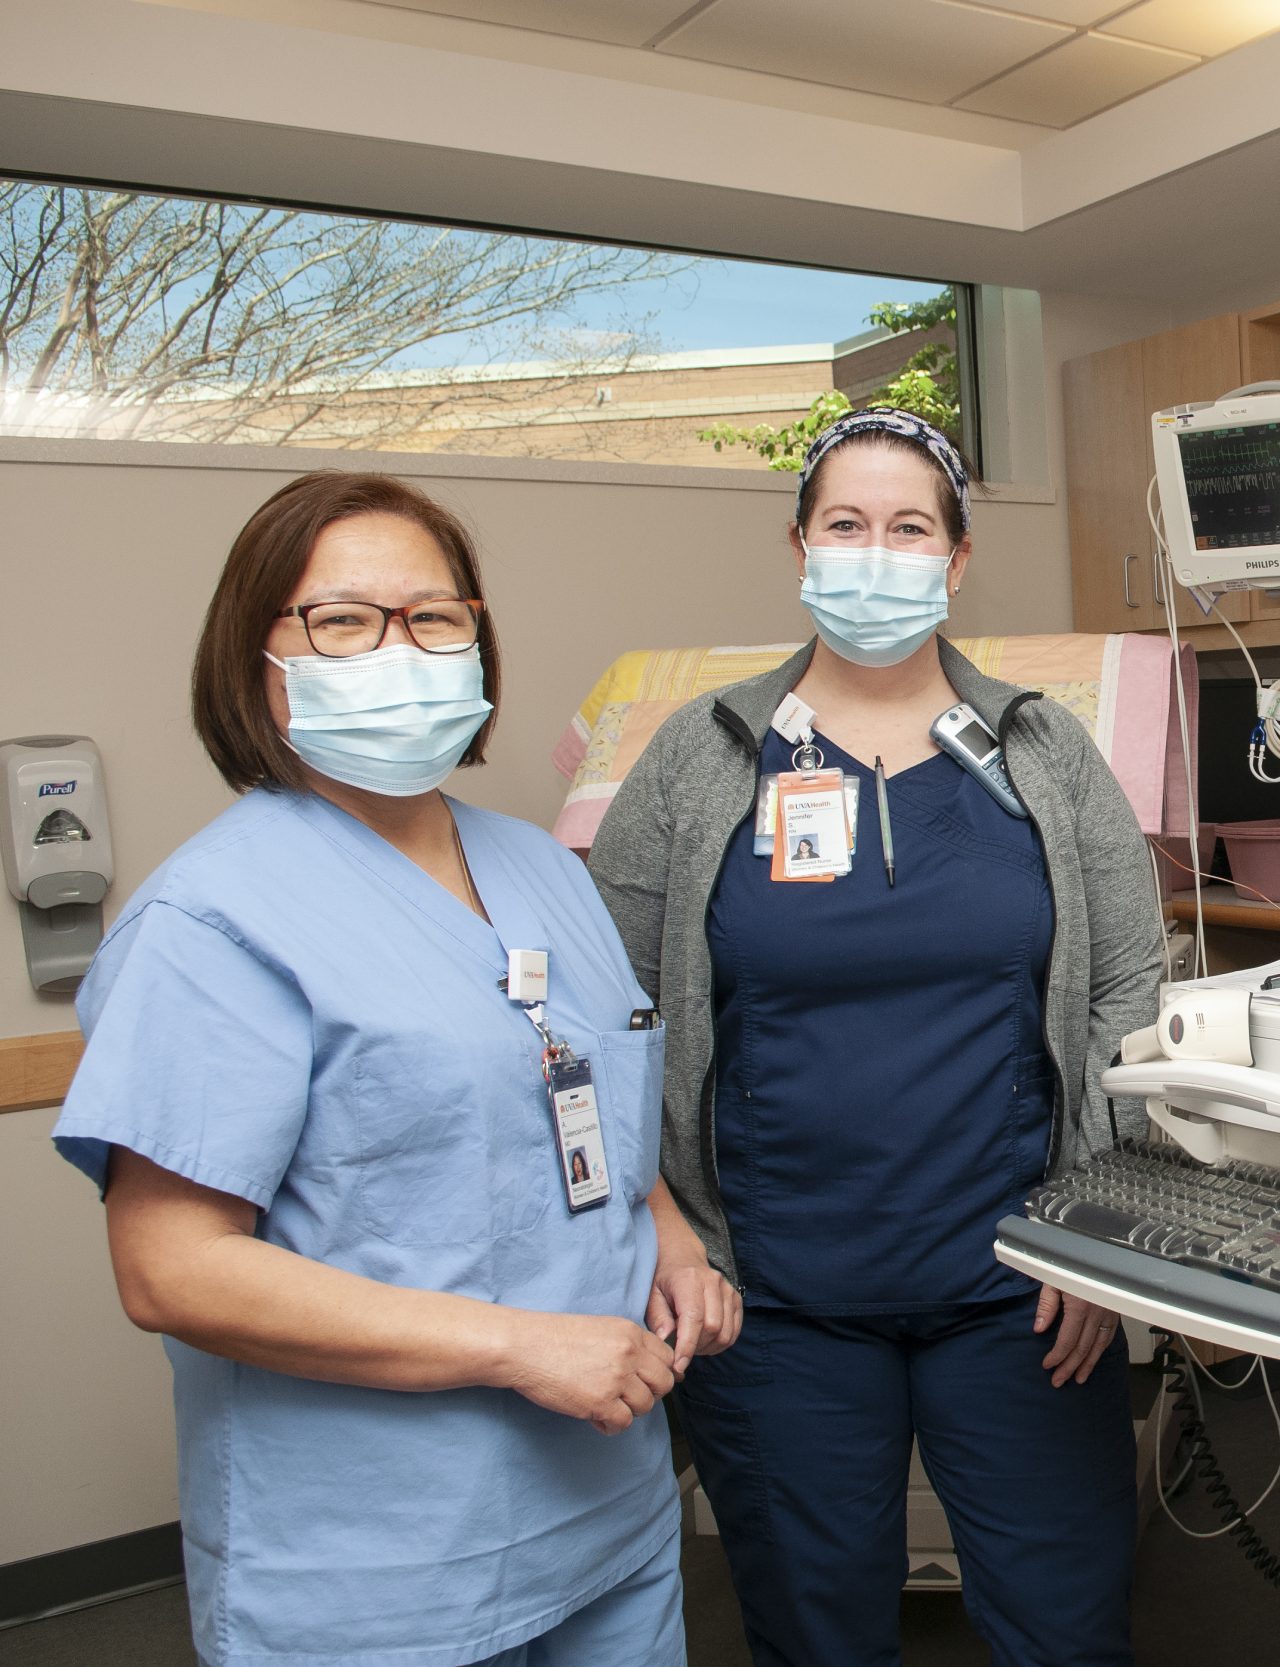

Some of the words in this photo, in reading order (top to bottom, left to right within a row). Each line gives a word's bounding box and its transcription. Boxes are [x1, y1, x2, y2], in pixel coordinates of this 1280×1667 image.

[1245, 559, 1280, 570] PHILIPS
[43, 783, 73, 795] Purell
[795, 801, 831, 810] UVAHealth
[787, 813, 814, 821] Jennifer
